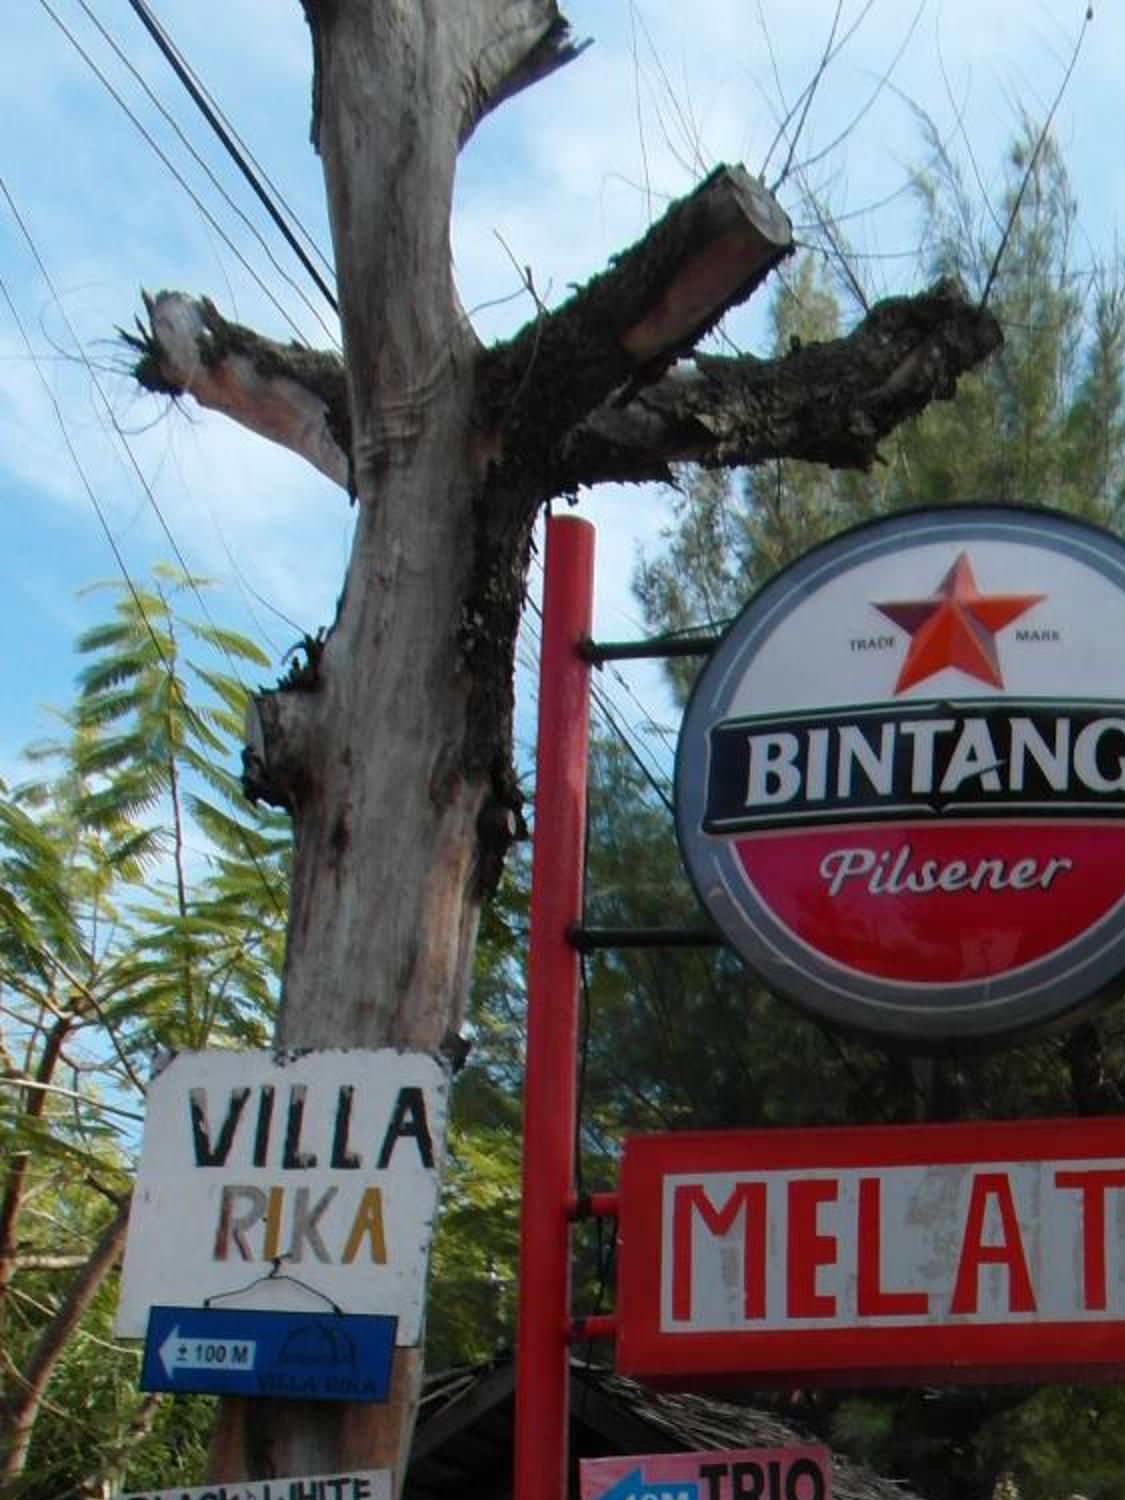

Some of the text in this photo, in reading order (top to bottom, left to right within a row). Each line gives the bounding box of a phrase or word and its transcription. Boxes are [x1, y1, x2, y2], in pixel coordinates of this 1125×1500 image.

[848, 629, 1060, 653] TRADE MARK
[818, 846, 1074, 897] Pilsener
[188, 1084, 435, 1171] VILLA
[213, 1185, 388, 1266] RIKA
[195, 1343, 227, 1363] 100
[231, 1345, 249, 1364] M
